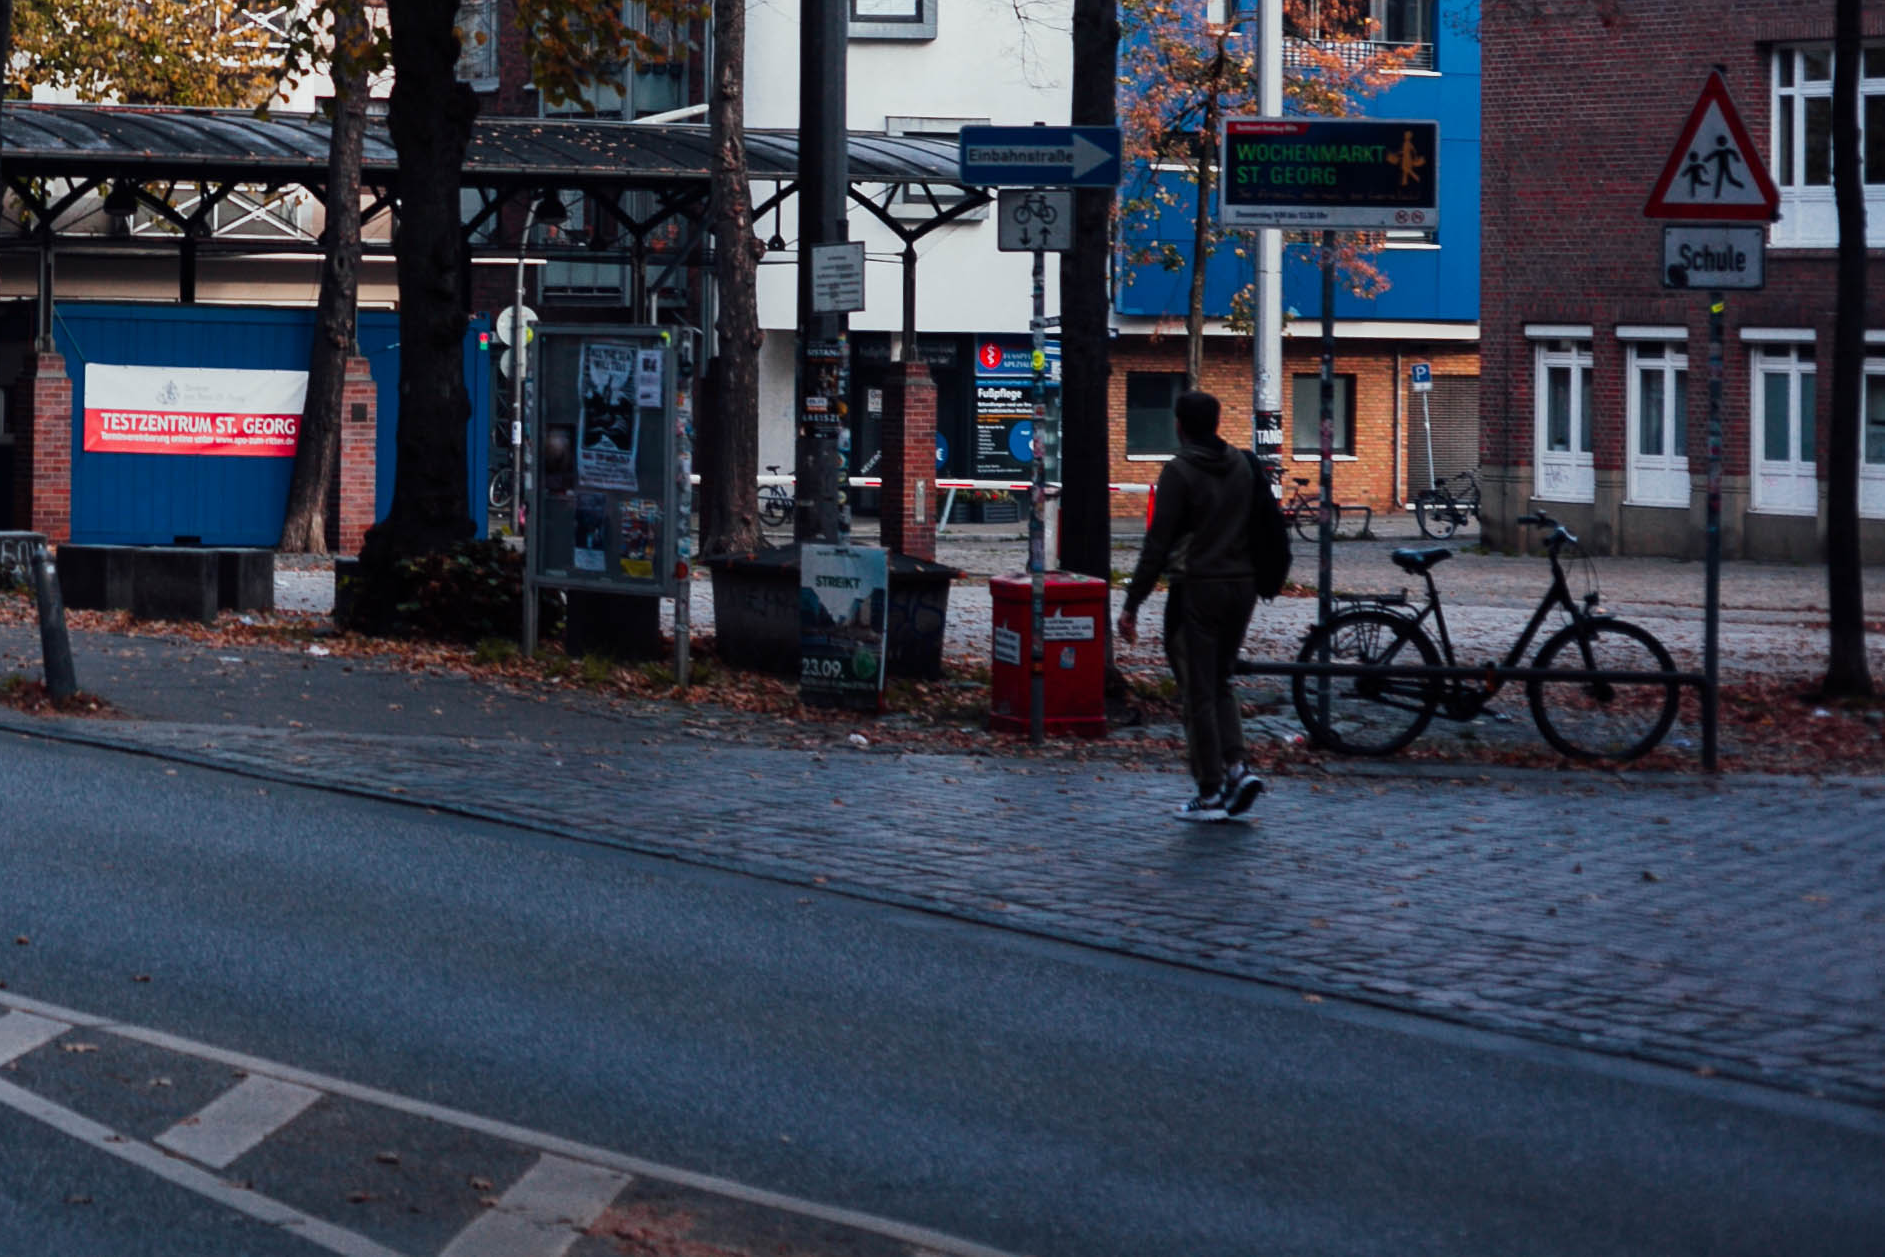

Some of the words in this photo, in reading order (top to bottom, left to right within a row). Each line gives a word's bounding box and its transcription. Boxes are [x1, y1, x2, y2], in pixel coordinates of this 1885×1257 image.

[969, 148, 1074, 163] Einbahnstraße
[1235, 143, 1386, 164] WOCHENMARKT
[1235, 166, 1264, 184] ST.
[1269, 167, 1338, 186] GEORG
[1680, 243, 1746, 271] Schule
[1416, 366, 1427, 381] P
[977, 387, 1023, 401] Fußpflege
[100, 412, 212, 433] TESTZENTRUM
[215, 418, 237, 434] ST.
[243, 418, 296, 435] GEORG
[815, 575, 861, 590] STREIKT
[802, 656, 845, 679] 23.09.
